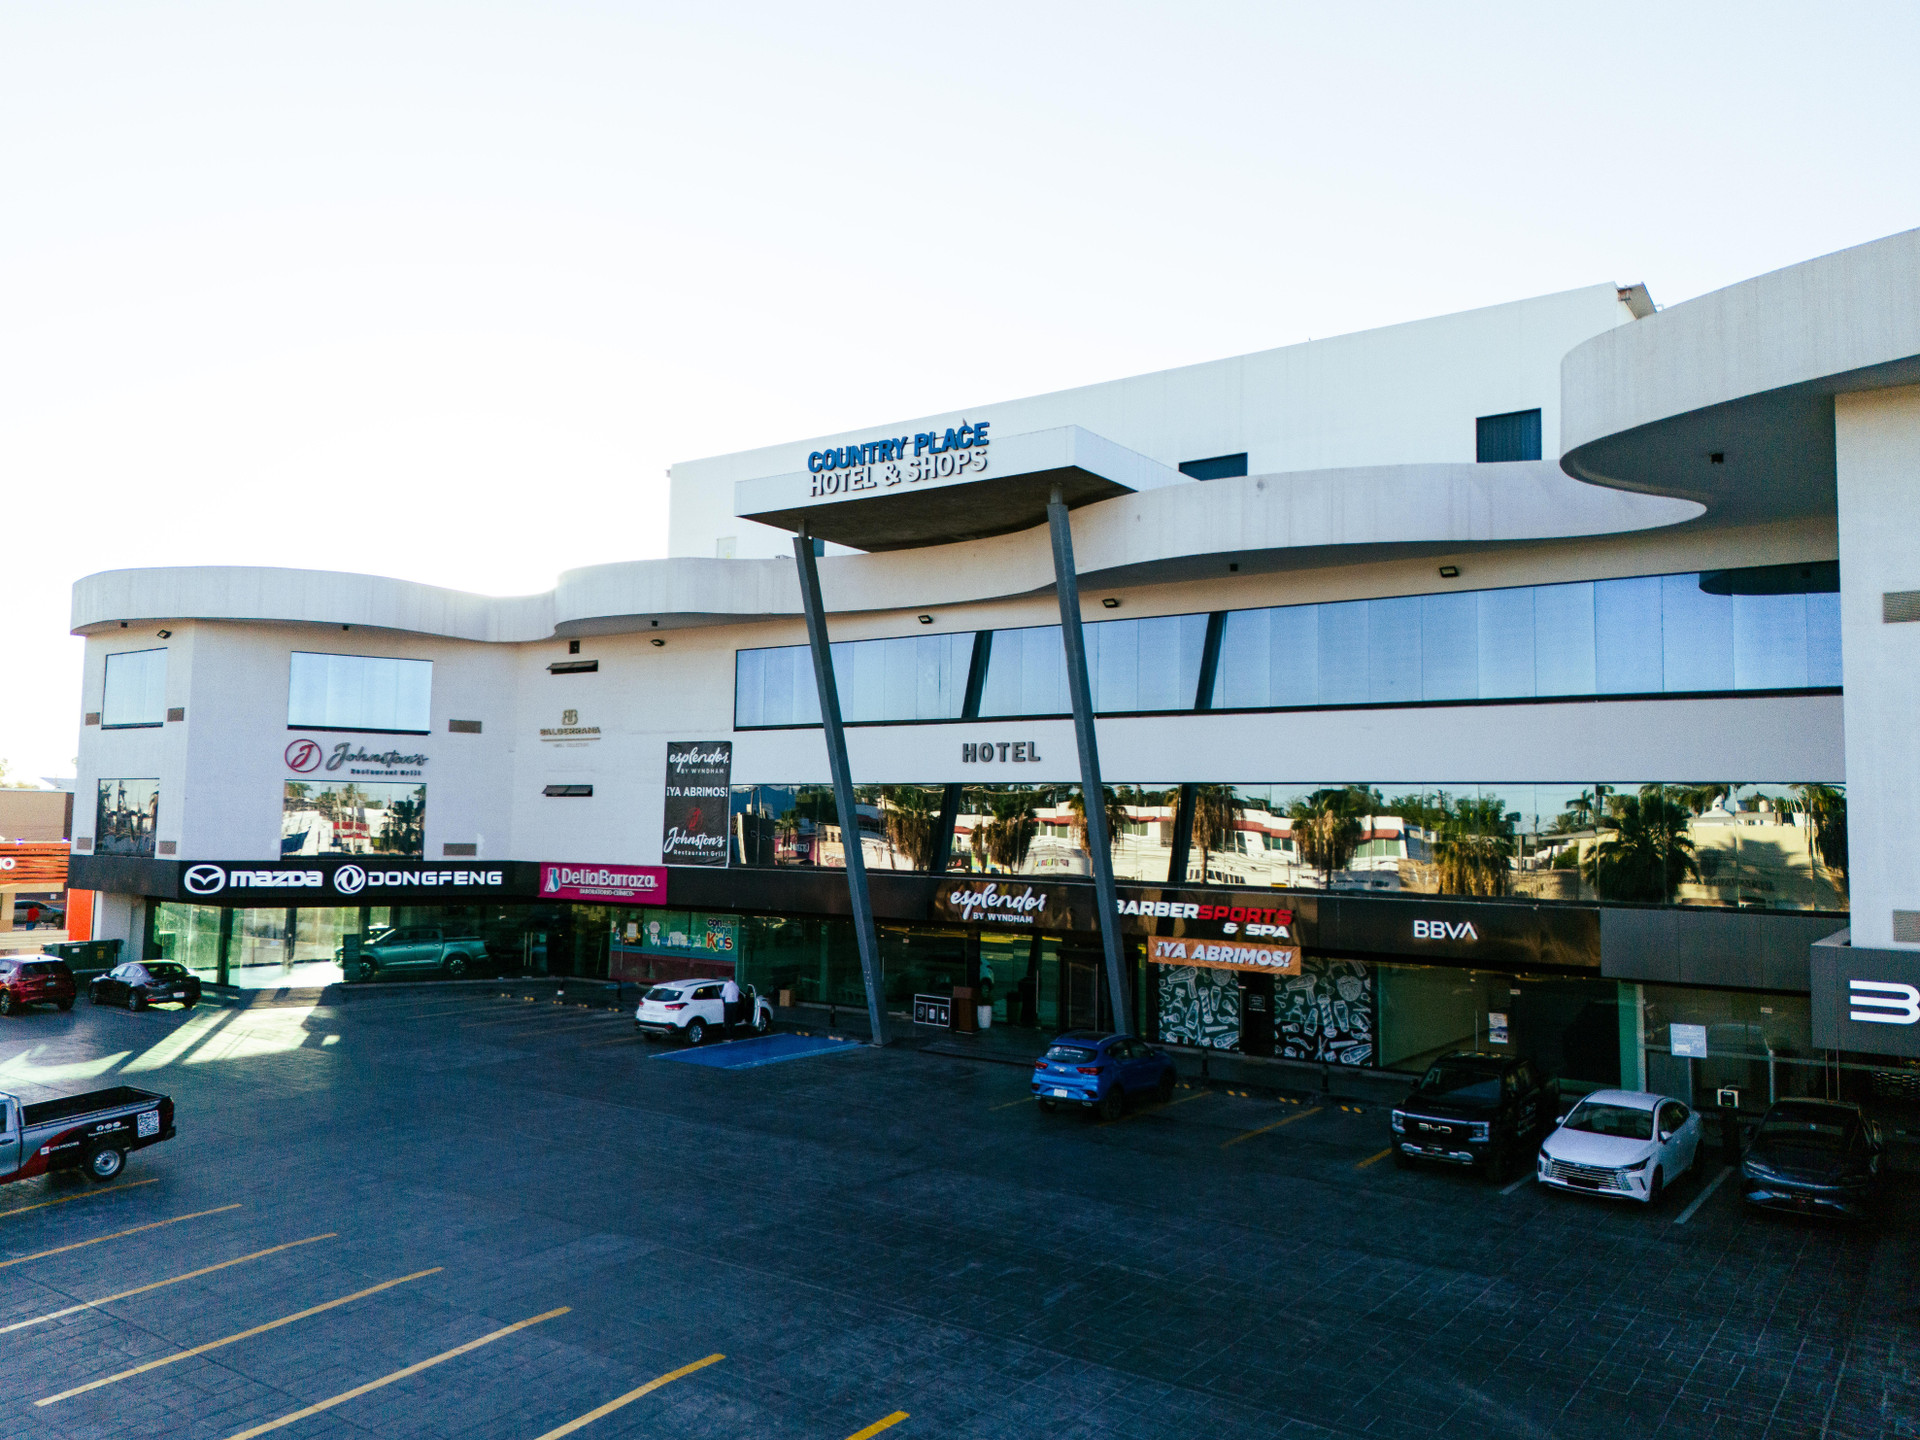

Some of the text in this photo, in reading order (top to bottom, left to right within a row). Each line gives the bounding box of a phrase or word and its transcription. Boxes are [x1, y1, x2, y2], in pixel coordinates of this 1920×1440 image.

[808, 421, 990, 473] COUNTRY PLACE
[809, 448, 987, 497] HOTEL & SHOPS
[326, 742, 429, 771] Johnston's
[962, 741, 1041, 763] HOTEL
[683, 786, 728, 797] ABRIMOS!
[663, 827, 725, 853] Johnston's
[368, 871, 503, 885] DONGFENG
[950, 883, 1047, 920] esplendor
[973, 912, 1033, 923] BY WYNDHAM
[1222, 922, 1290, 938] & SPA
[1413, 920, 1478, 940] BBVA
[706, 931, 733, 951] Kids
[1156, 942, 1292, 968] ¡YA ABRIMOS!
[1418, 1122, 1452, 1134] BYD
